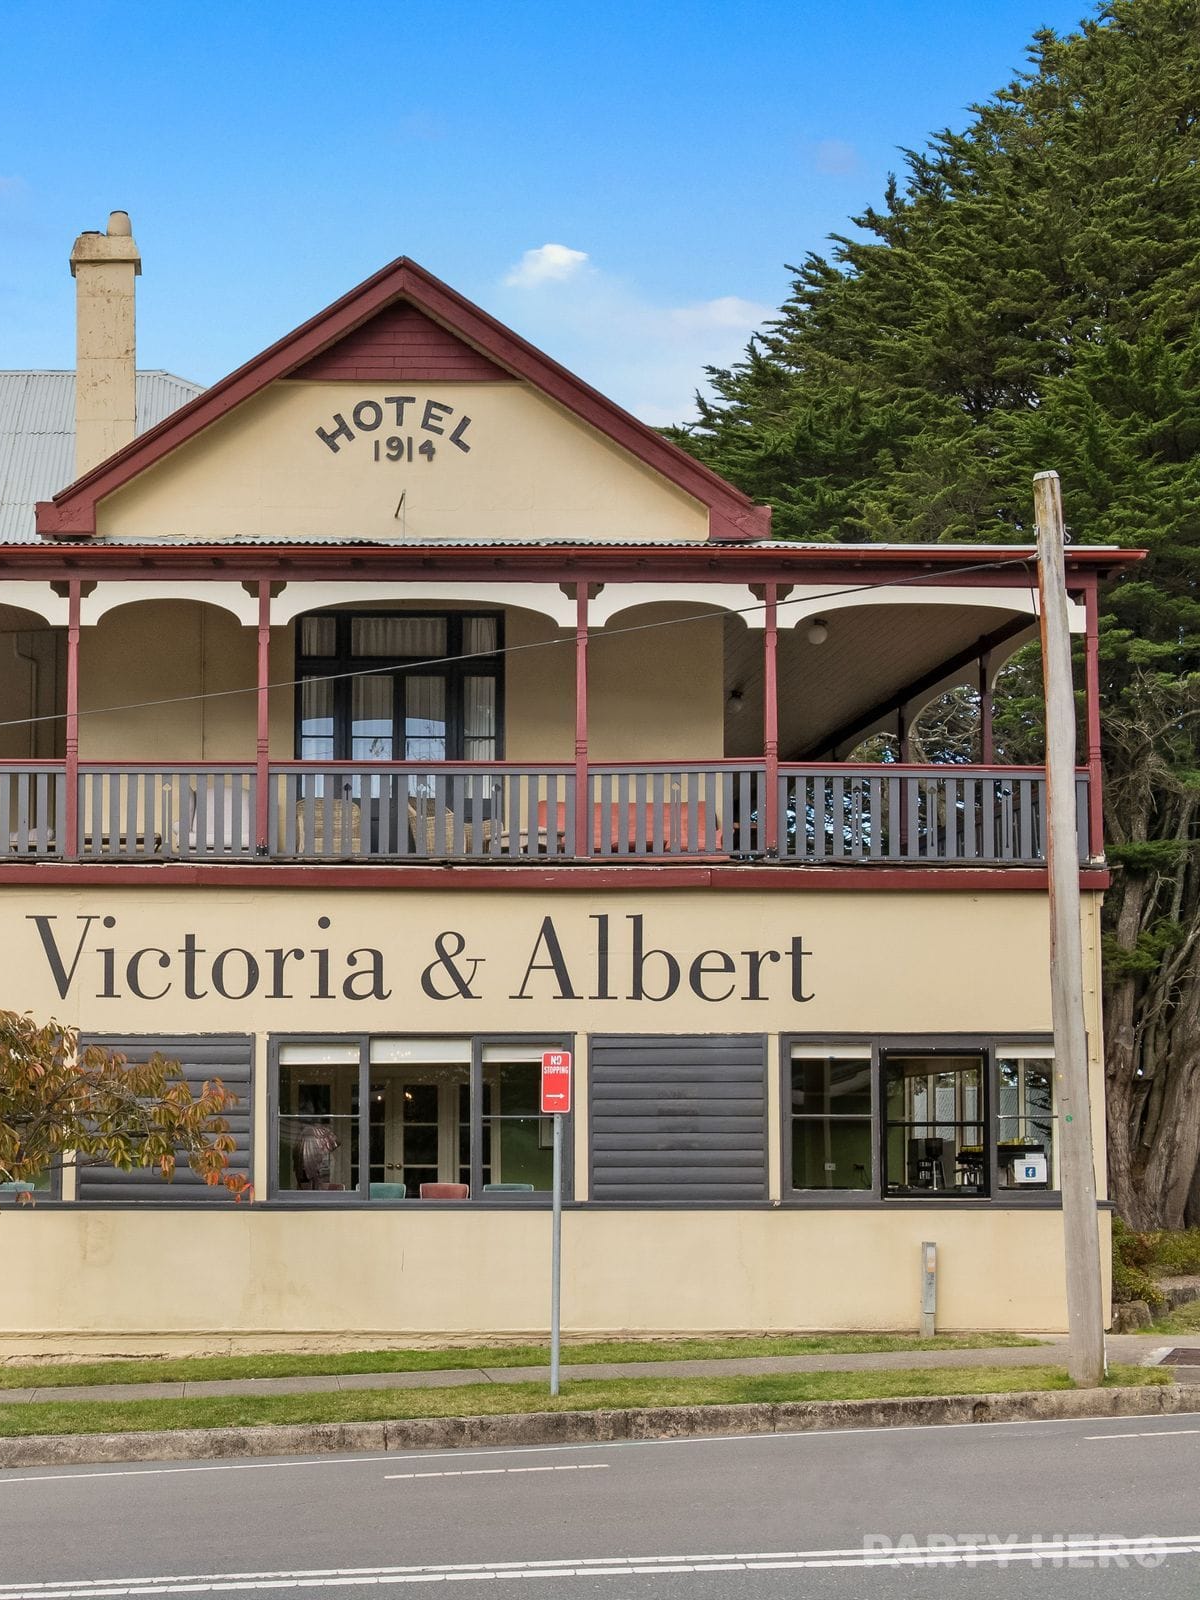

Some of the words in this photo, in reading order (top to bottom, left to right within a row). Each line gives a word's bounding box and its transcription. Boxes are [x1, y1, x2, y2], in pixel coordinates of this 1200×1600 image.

[315, 396, 472, 454] HOTEL
[374, 436, 436, 462] 1914
[26, 915, 392, 1001] Victoria
[421, 931, 485, 1001] &
[510, 914, 816, 1003] Albert
[543, 1066, 569, 1075] STOPPING
[550, 1055, 562, 1065] NO
